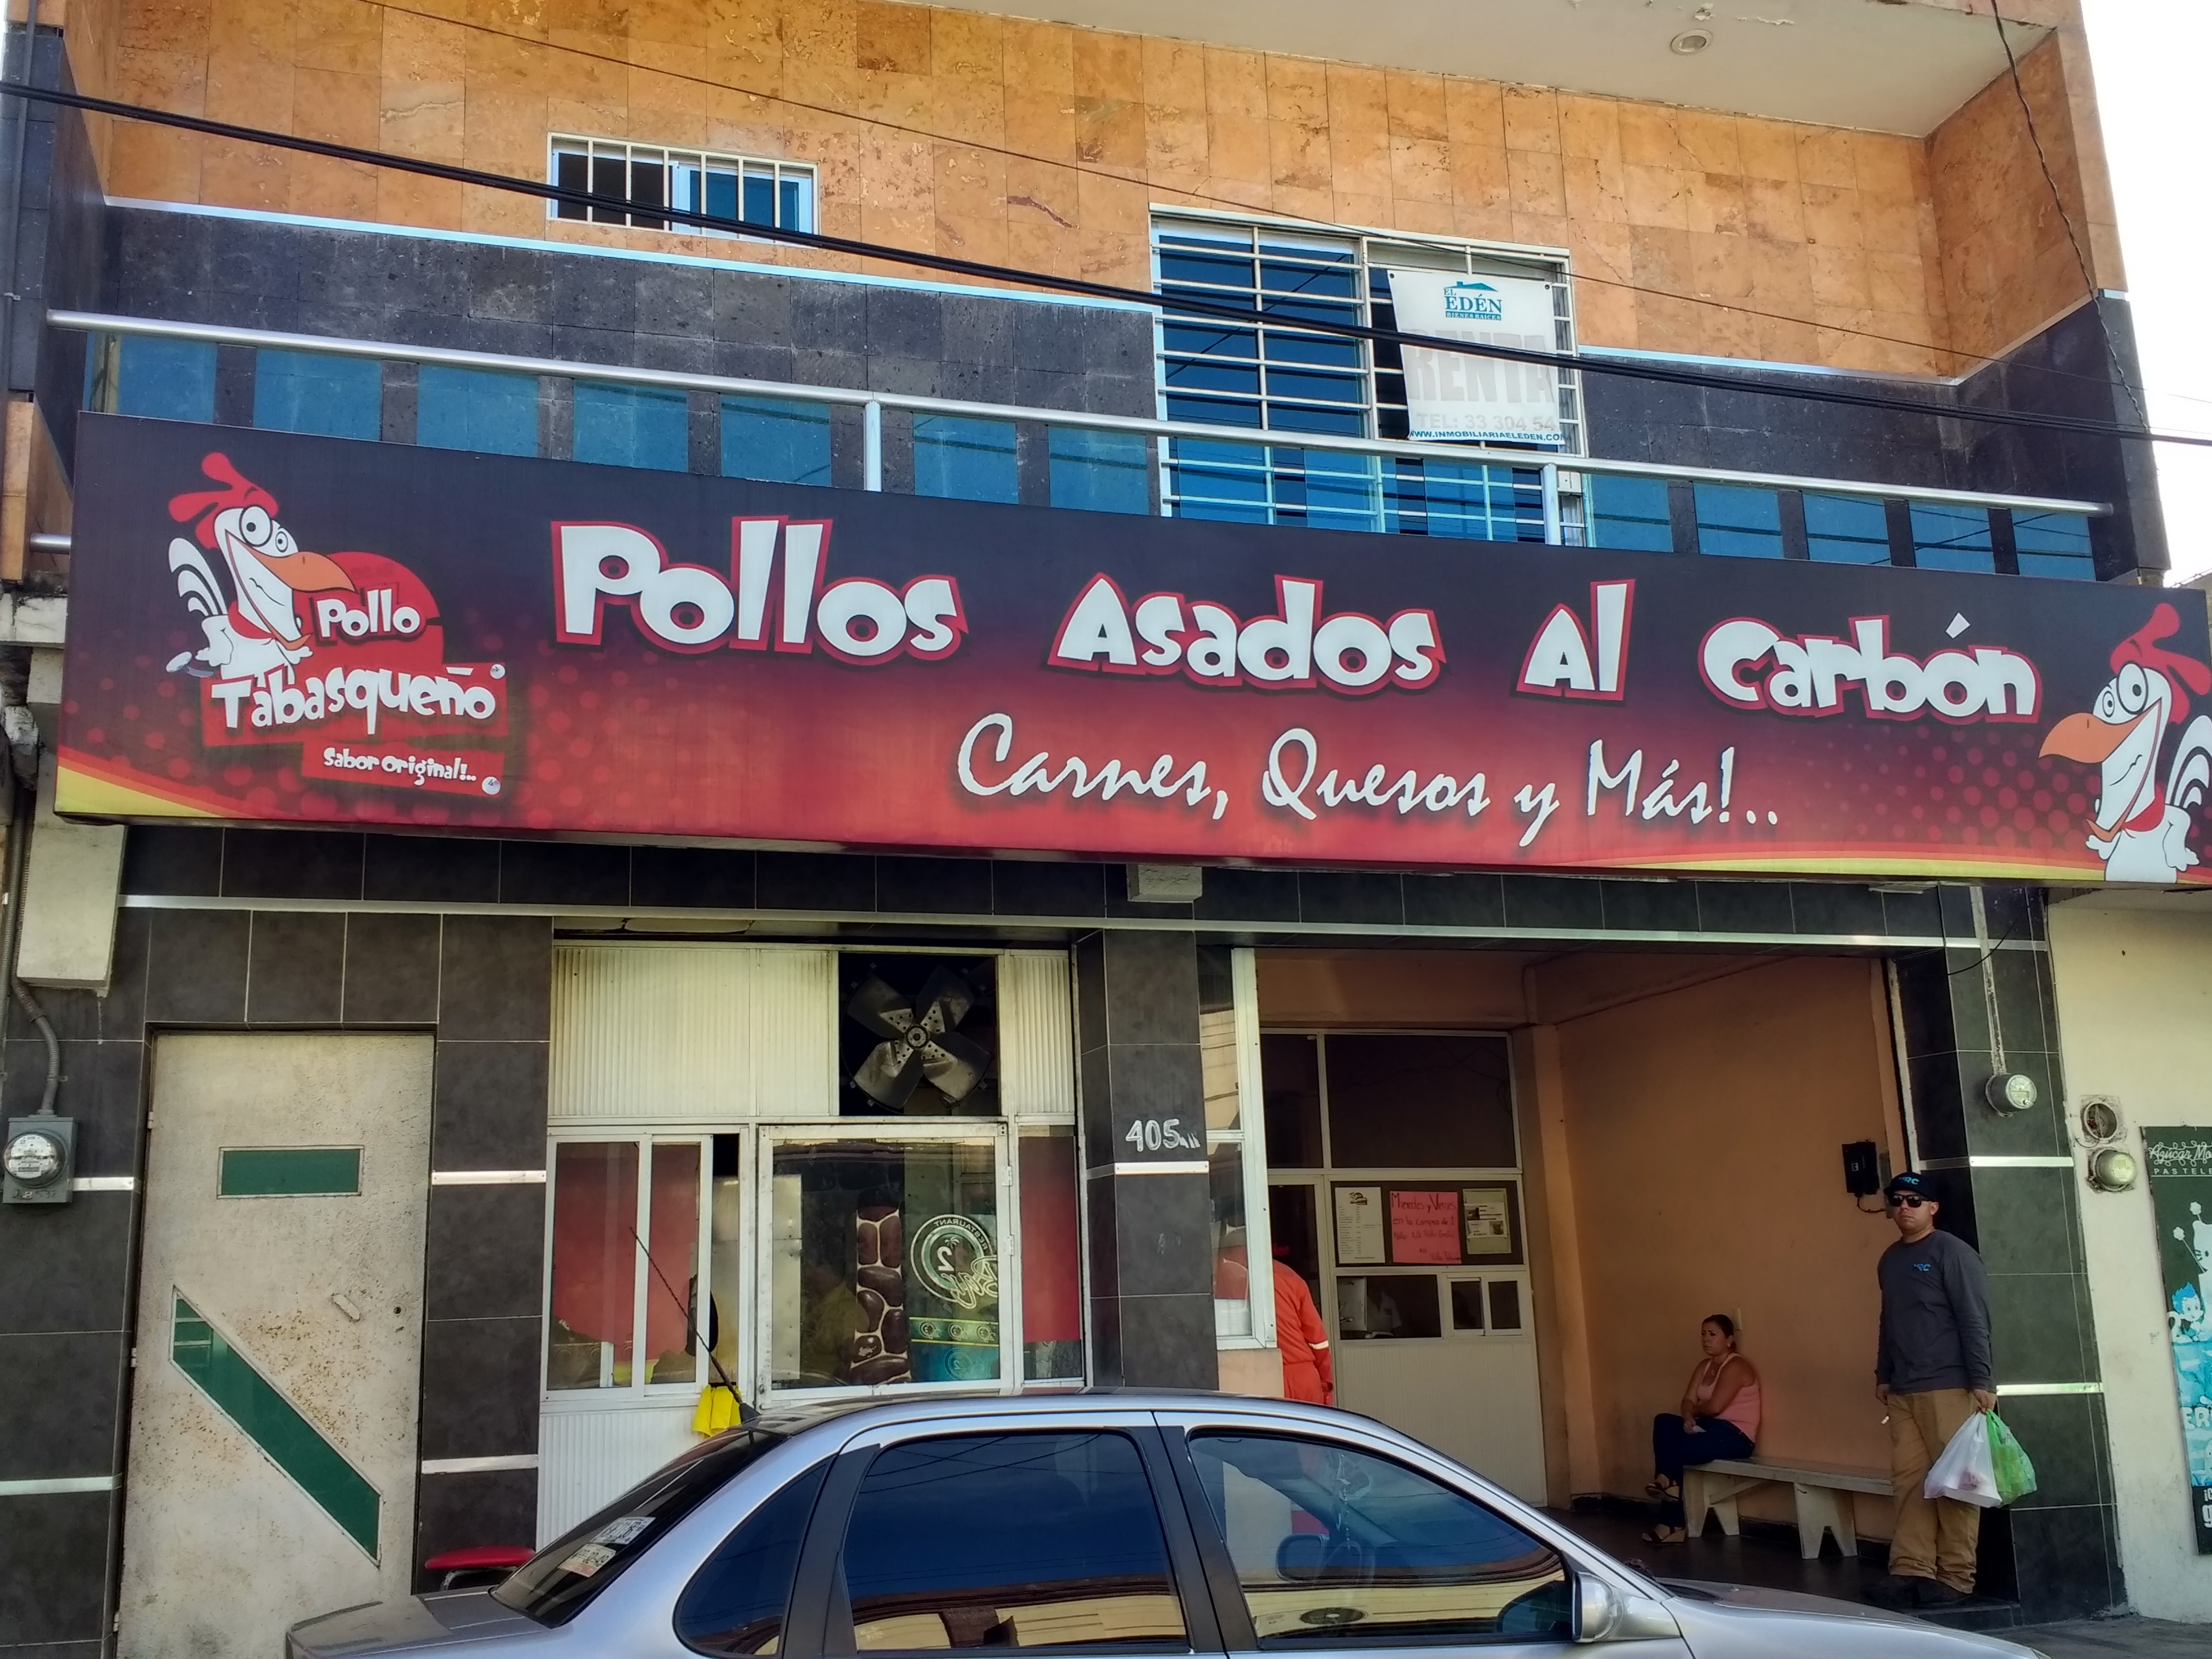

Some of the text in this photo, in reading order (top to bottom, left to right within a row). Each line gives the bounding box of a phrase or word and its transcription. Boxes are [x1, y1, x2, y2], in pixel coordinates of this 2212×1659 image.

[1444, 294, 1502, 314] EDÉN
[1402, 329, 1554, 403] RENTA
[1417, 412, 1555, 431] TEL: 33 304 54
[316, 589, 420, 638] Pollo
[559, 518, 2038, 717] Pollos Asados Al Carbón
[211, 666, 496, 735] Tabasqueño
[323, 747, 380, 770] Sabor
[958, 713, 1228, 820] Carnes,
[1262, 727, 1490, 820] Quesos
[1514, 783, 1560, 847] y
[1125, 1118, 1180, 1152] 405
